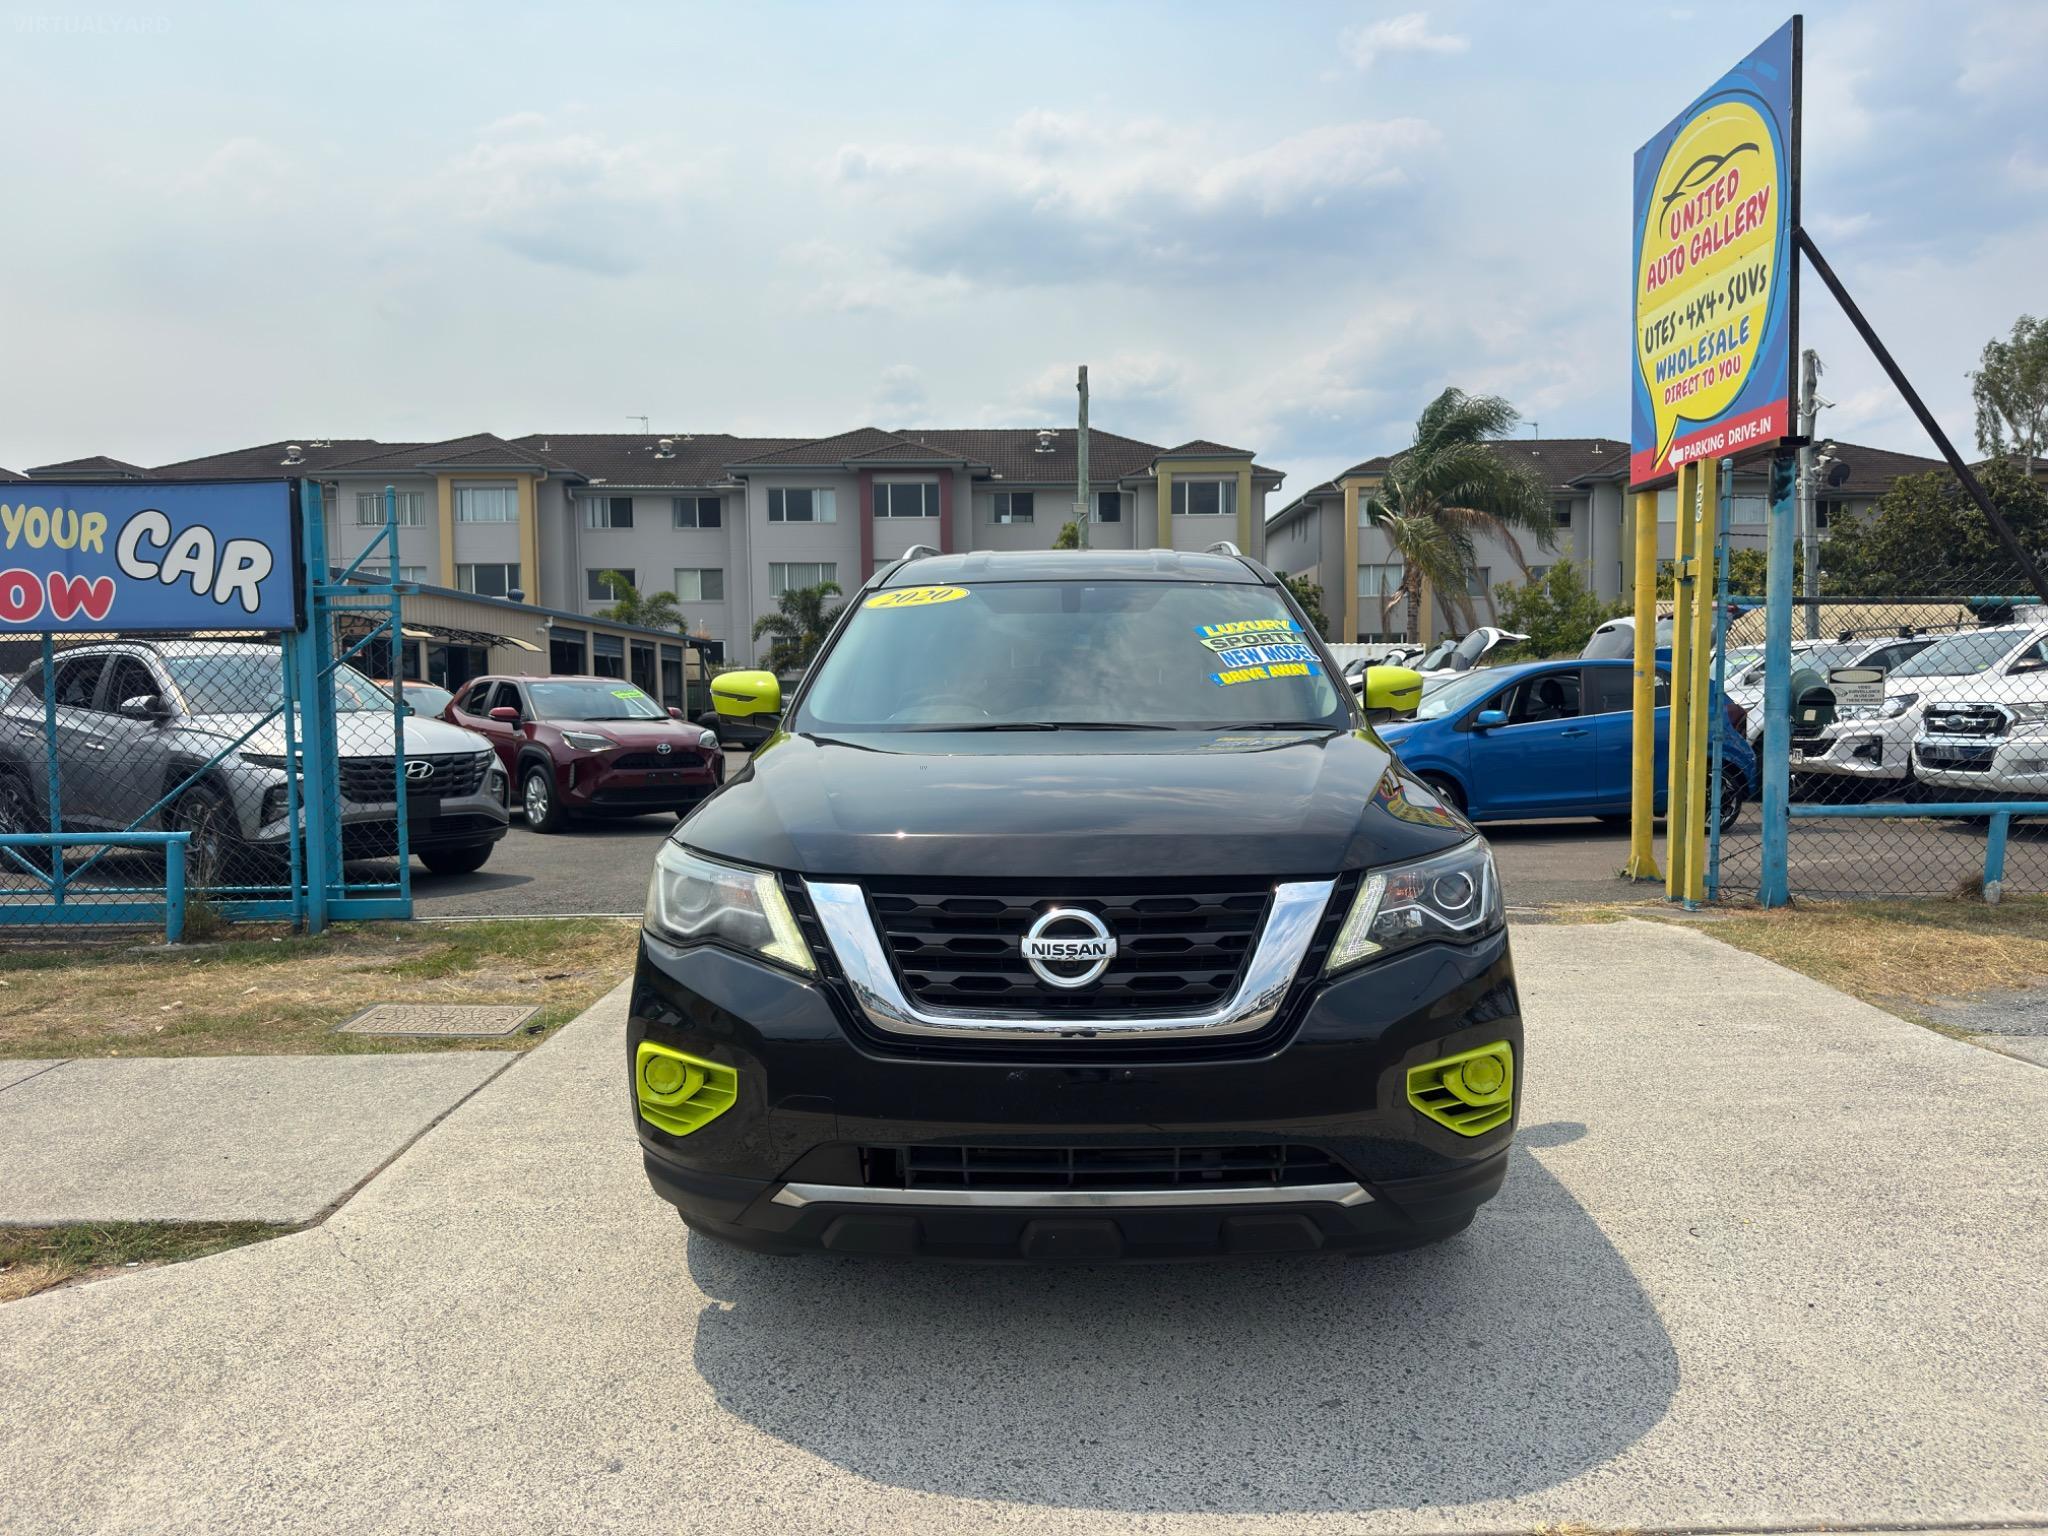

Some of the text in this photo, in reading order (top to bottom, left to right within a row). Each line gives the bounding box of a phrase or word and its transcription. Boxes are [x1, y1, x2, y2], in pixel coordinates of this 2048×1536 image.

[1670, 168, 1739, 241] UNITED
[1647, 184, 1770, 294] AUTO GALLERY
[1645, 310, 1676, 354] UTES
[1655, 315, 1750, 384] WHOLESALE
[1664, 354, 1742, 405] DIRECT TO YOU
[1684, 415, 1772, 460] PARKING DRIVE-IN
[1, 503, 273, 614] YOUR CAR
[877, 588, 954, 606] 2020
[1203, 619, 1291, 637] LUXURY
[1210, 632, 1298, 649] SPORTY
[1219, 644, 1320, 667] NEW MODEL
[1219, 663, 1311, 685] DRIVE AWAY
[1031, 943, 1107, 956] NISSAN
